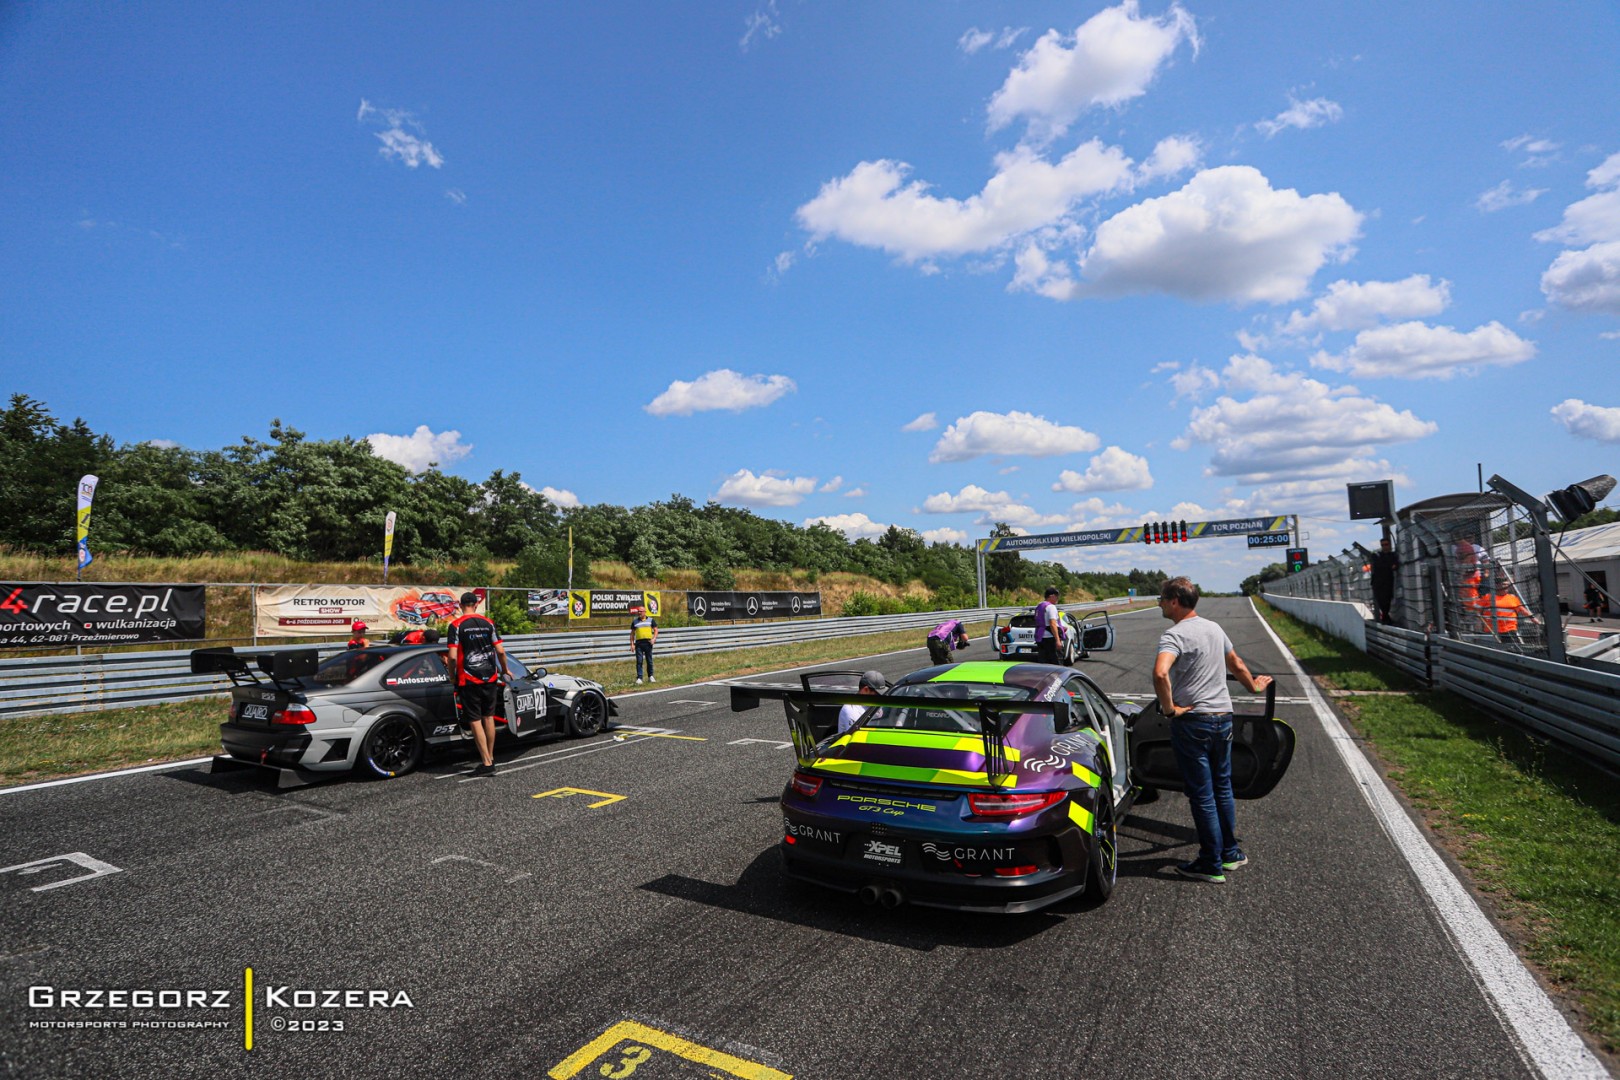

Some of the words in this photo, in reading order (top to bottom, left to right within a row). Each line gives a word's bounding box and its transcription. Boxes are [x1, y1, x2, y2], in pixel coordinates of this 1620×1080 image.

[1212, 523, 1228, 531] TOR
[1006, 534, 1060, 547] AUTOMOBILKLUB
[1060, 532, 1111, 543] WIELKOPOLSKI
[1248, 534, 1289, 545] 00:25:00
[293, 598, 328, 606] RETRO
[330, 598, 366, 606] MOTOR
[592, 593, 614, 601] POLSKI
[616, 593, 642, 603] ZWIĄZEK
[591, 602, 629, 610] MOTOROWY
[96, 619, 177, 630] wulkanizacja
[10, 636, 27, 644] 44,
[30, 634, 68, 643] 62-081
[70, 633, 140, 642] Przeźmierowo
[397, 674, 447, 685] Antoszewski
[535, 690, 545, 715] 27
[926, 711, 951, 719] RECARO
[1051, 734, 1092, 756] GRANT
[837, 795, 937, 812] PORSCHE
[858, 805, 881, 813] GT3
[883, 807, 905, 817] Cup
[799, 824, 841, 844] GRANT
[870, 840, 902, 856] XPEL
[954, 847, 1015, 860] GRANT
[863, 854, 901, 864] MOTORSPORTS
[600, 1046, 651, 1079] 3
